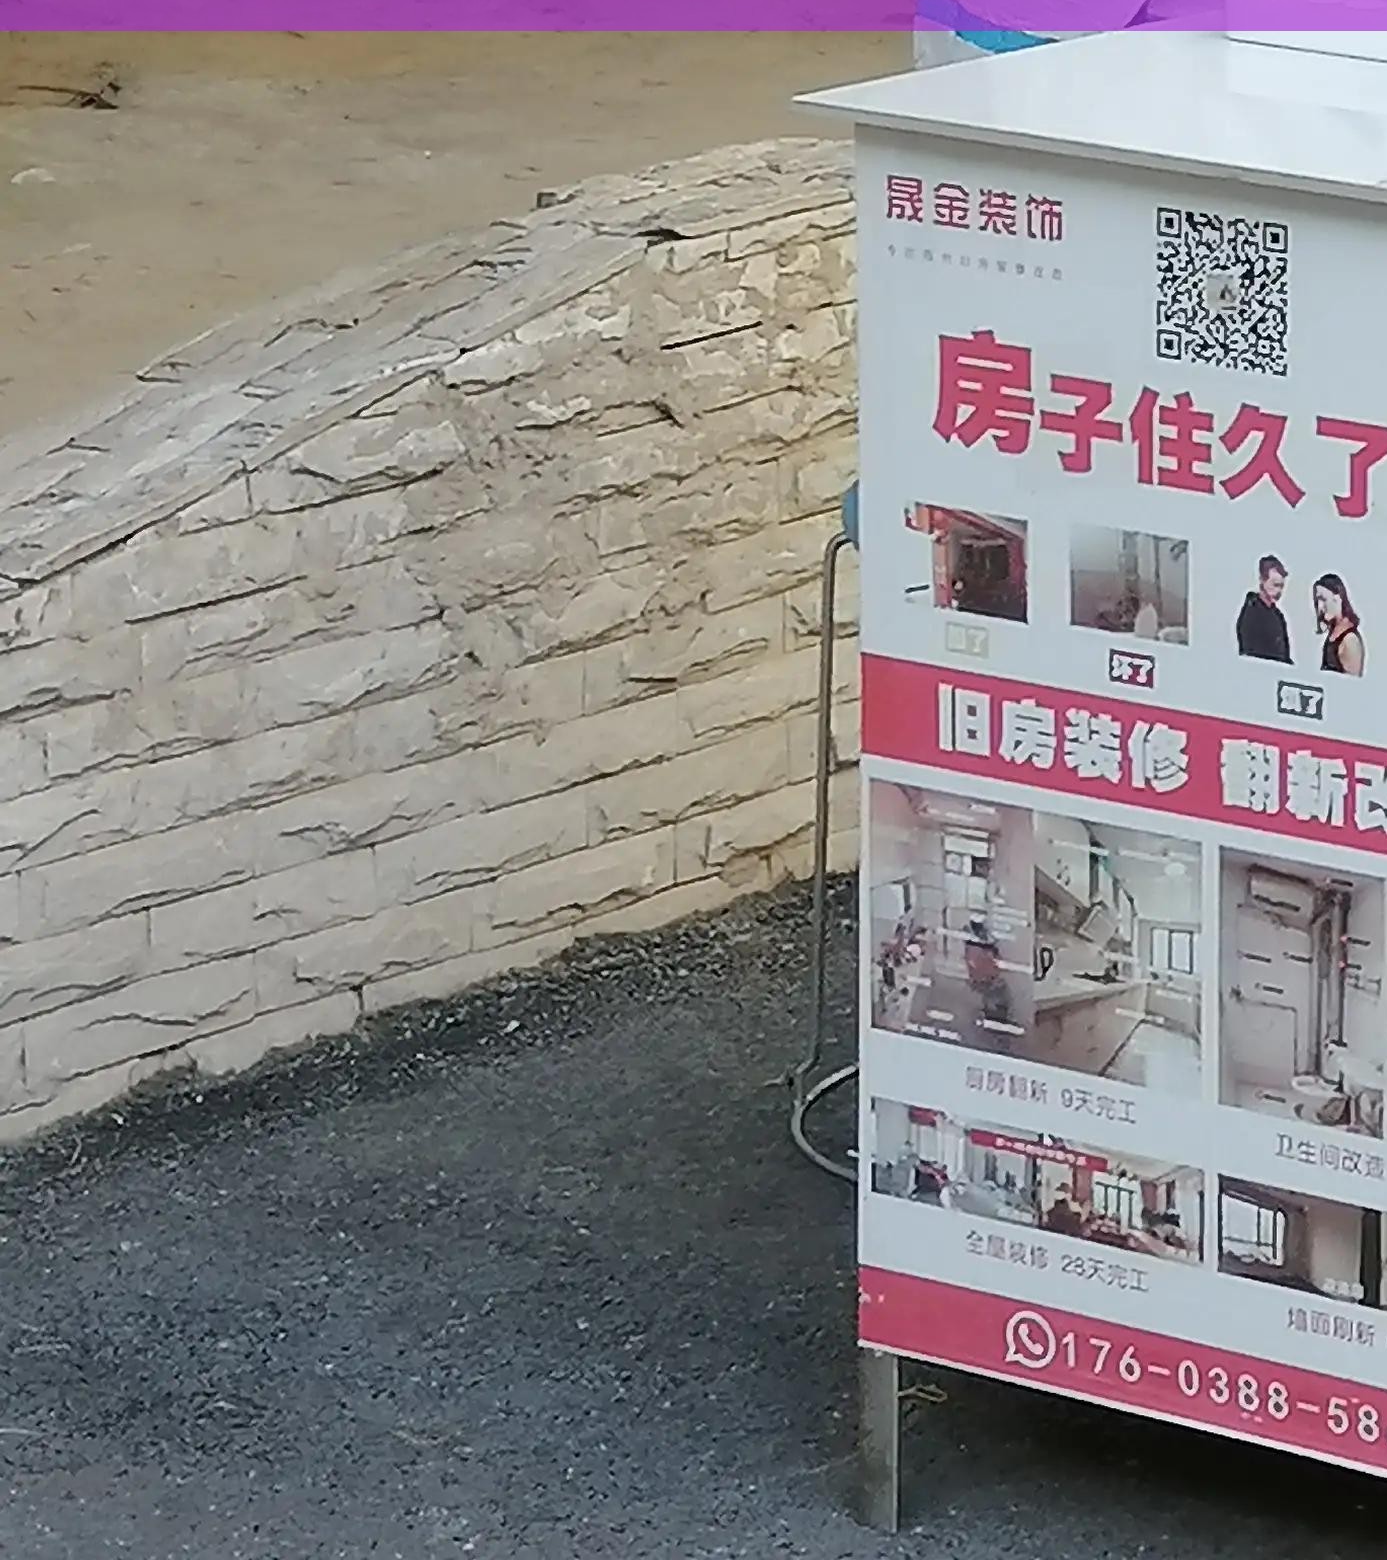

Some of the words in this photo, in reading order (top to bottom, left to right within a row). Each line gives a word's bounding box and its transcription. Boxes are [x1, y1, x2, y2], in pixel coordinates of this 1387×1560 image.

[886, 174, 1063, 241] 晟金装饰
[937, 682, 1192, 794] 旧房装修
[1275, 1132, 1385, 1181] 卫生间改造
